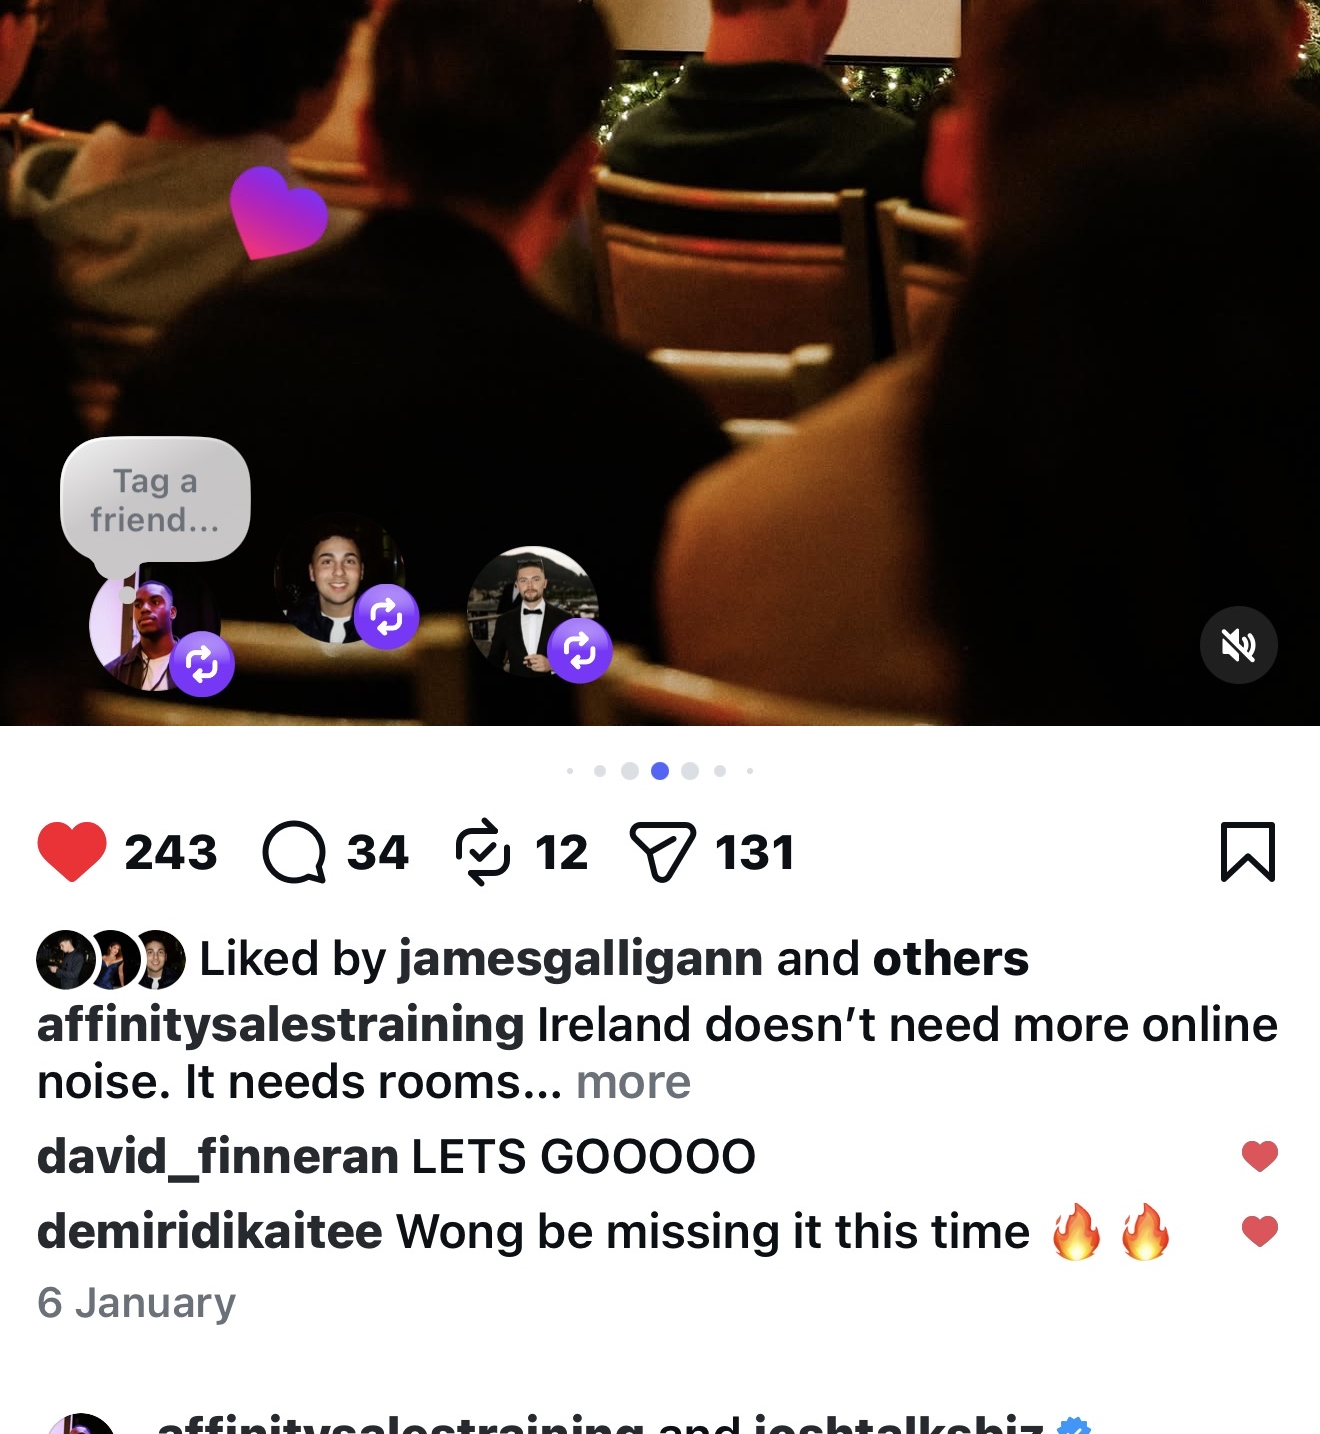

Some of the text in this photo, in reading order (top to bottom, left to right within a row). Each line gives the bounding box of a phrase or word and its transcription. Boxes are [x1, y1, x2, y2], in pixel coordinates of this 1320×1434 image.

[126, 834, 216, 870] 243
[348, 834, 408, 870] 34
[537, 834, 587, 869] 12
[717, 834, 791, 870] 131
[202, 937, 1028, 984] Liked by jamesgalligann and others
[38, 1003, 1277, 1050] affinitysalestraining Ireland doesn’t need more online
[39, 1061, 690, 1099] noise. It needs rooms... more
[38, 1135, 755, 1183] david_finneran LETS GOOOOO
[38, 1210, 1029, 1257] demiridikaitee Wong be missing it this time
[39, 1287, 236, 1325] 6 January
